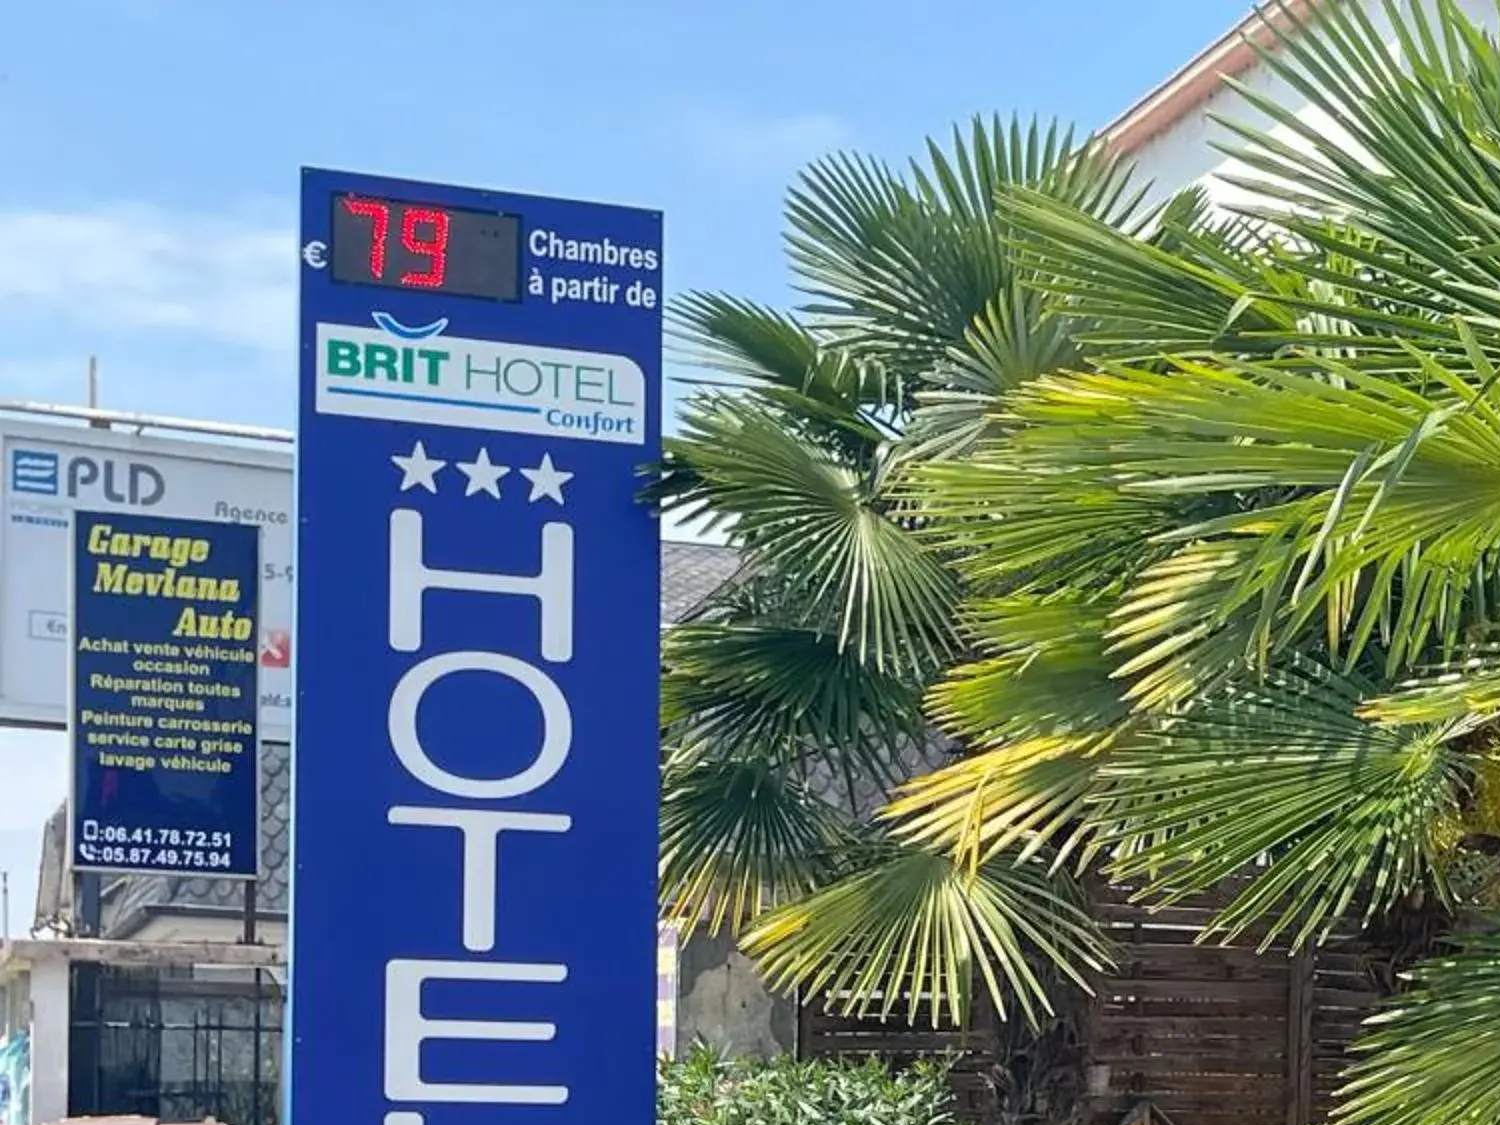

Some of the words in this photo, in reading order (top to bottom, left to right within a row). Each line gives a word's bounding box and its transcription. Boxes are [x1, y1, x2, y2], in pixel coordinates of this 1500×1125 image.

[341, 194, 451, 288] 79
[529, 229, 659, 271] Chambres
[303, 241, 328, 270] €
[529, 268, 543, 296] à
[551, 275, 619, 304] partir
[626, 281, 657, 308] de
[327, 339, 450, 386] BRIT
[465, 353, 635, 407] HOTEL
[545, 408, 635, 435] Confort
[67, 456, 166, 506] PLD
[87, 523, 211, 567] Garage
[172, 606, 253, 641] Auto
[79, 636, 129, 654] Achat
[132, 642, 180, 657] vente
[184, 643, 255, 663] véhicule
[132, 659, 210, 676] occasion
[90, 673, 184, 693] Réparation
[188, 681, 241, 698] toutes
[131, 695, 205, 713] marques
[81, 709, 153, 728] Peinture
[157, 717, 253, 735] carrosserie
[87, 731, 150, 748] service
[154, 735, 197, 750] carte
[201, 739, 243, 755] grise
[99, 750, 155, 770] lavage
[160, 755, 232, 773] véhicule
